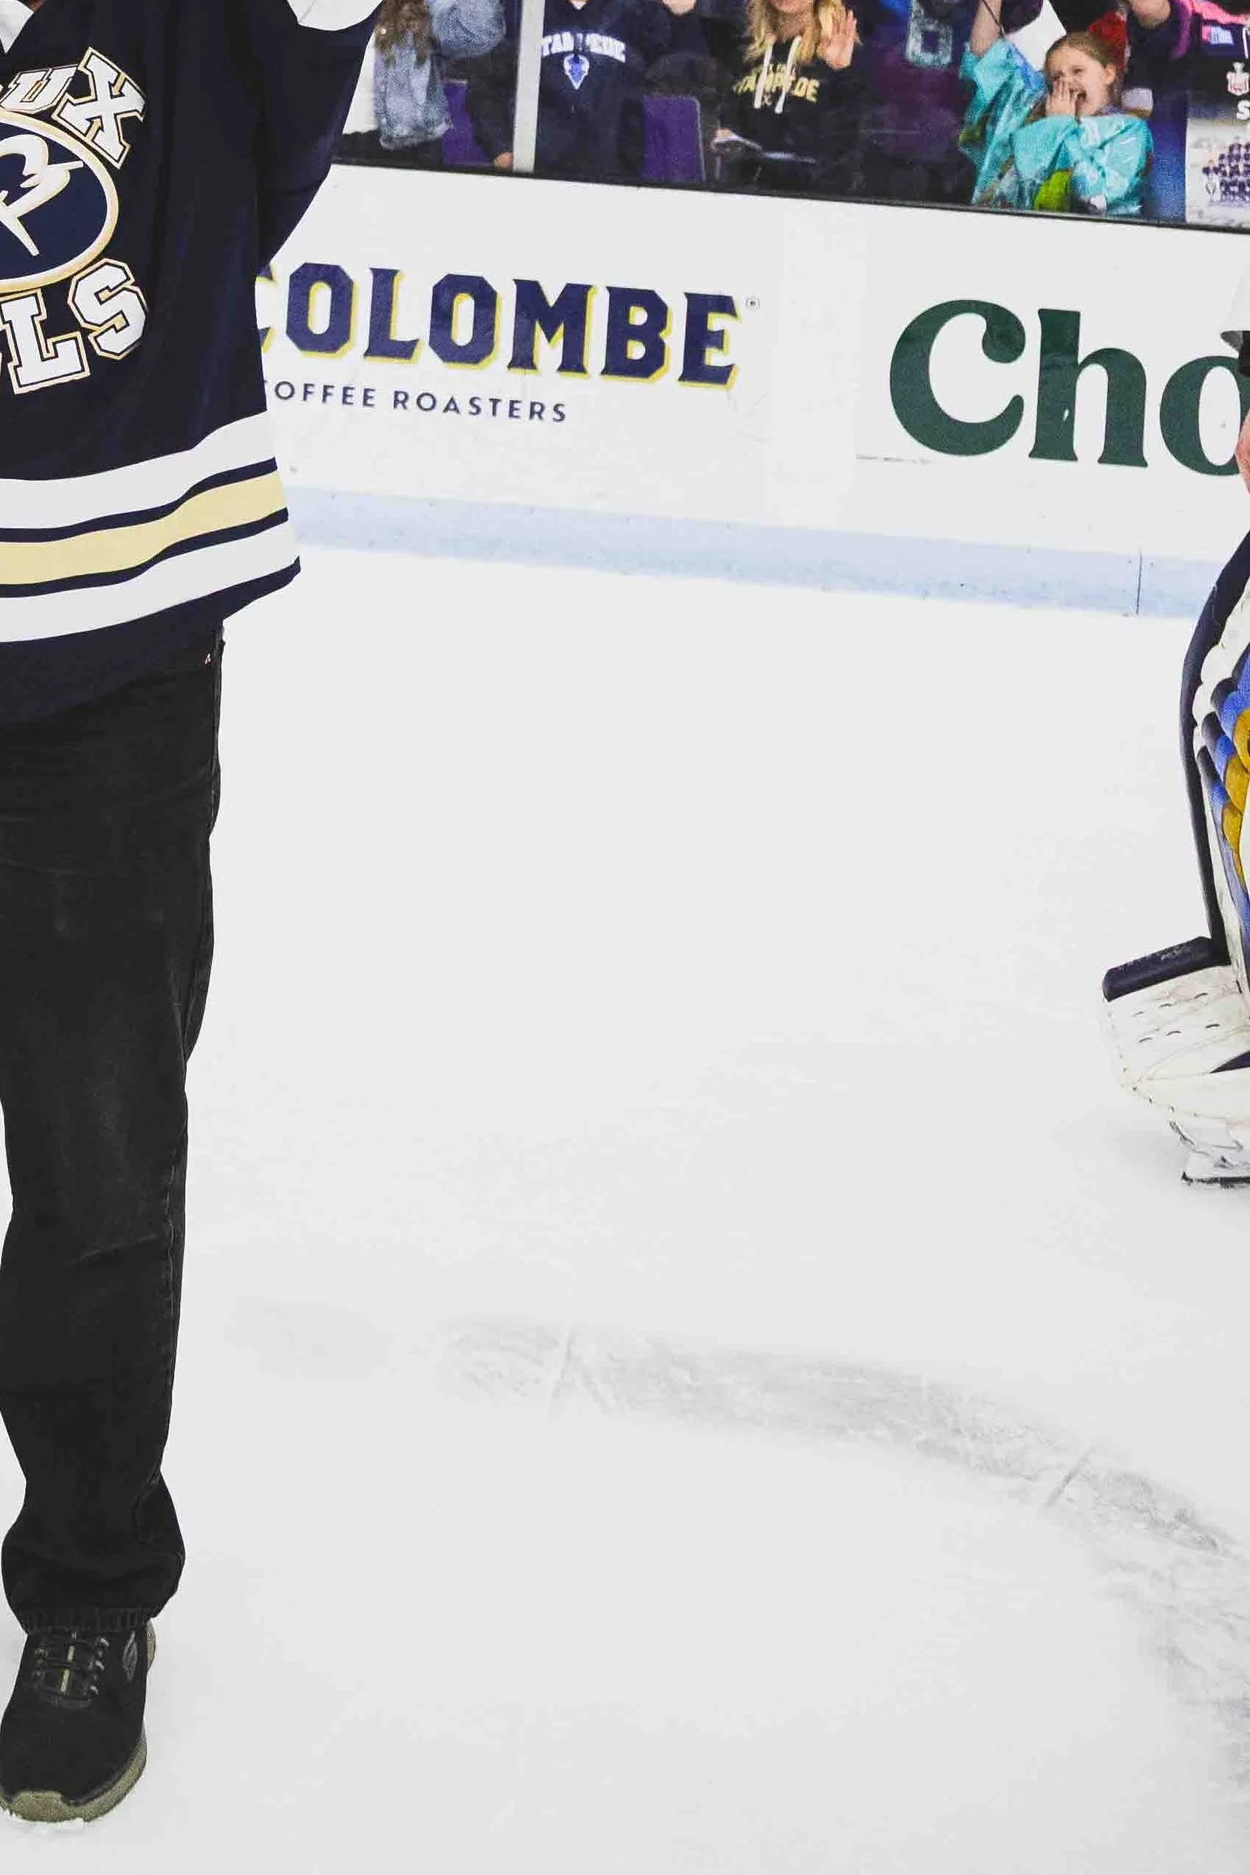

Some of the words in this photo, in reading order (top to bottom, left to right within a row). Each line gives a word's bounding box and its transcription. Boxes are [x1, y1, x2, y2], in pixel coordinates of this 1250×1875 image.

[258, 261, 742, 391] OLOMBE
[265, 379, 377, 408] OFFEE
[392, 389, 568, 424] ROASTERS
